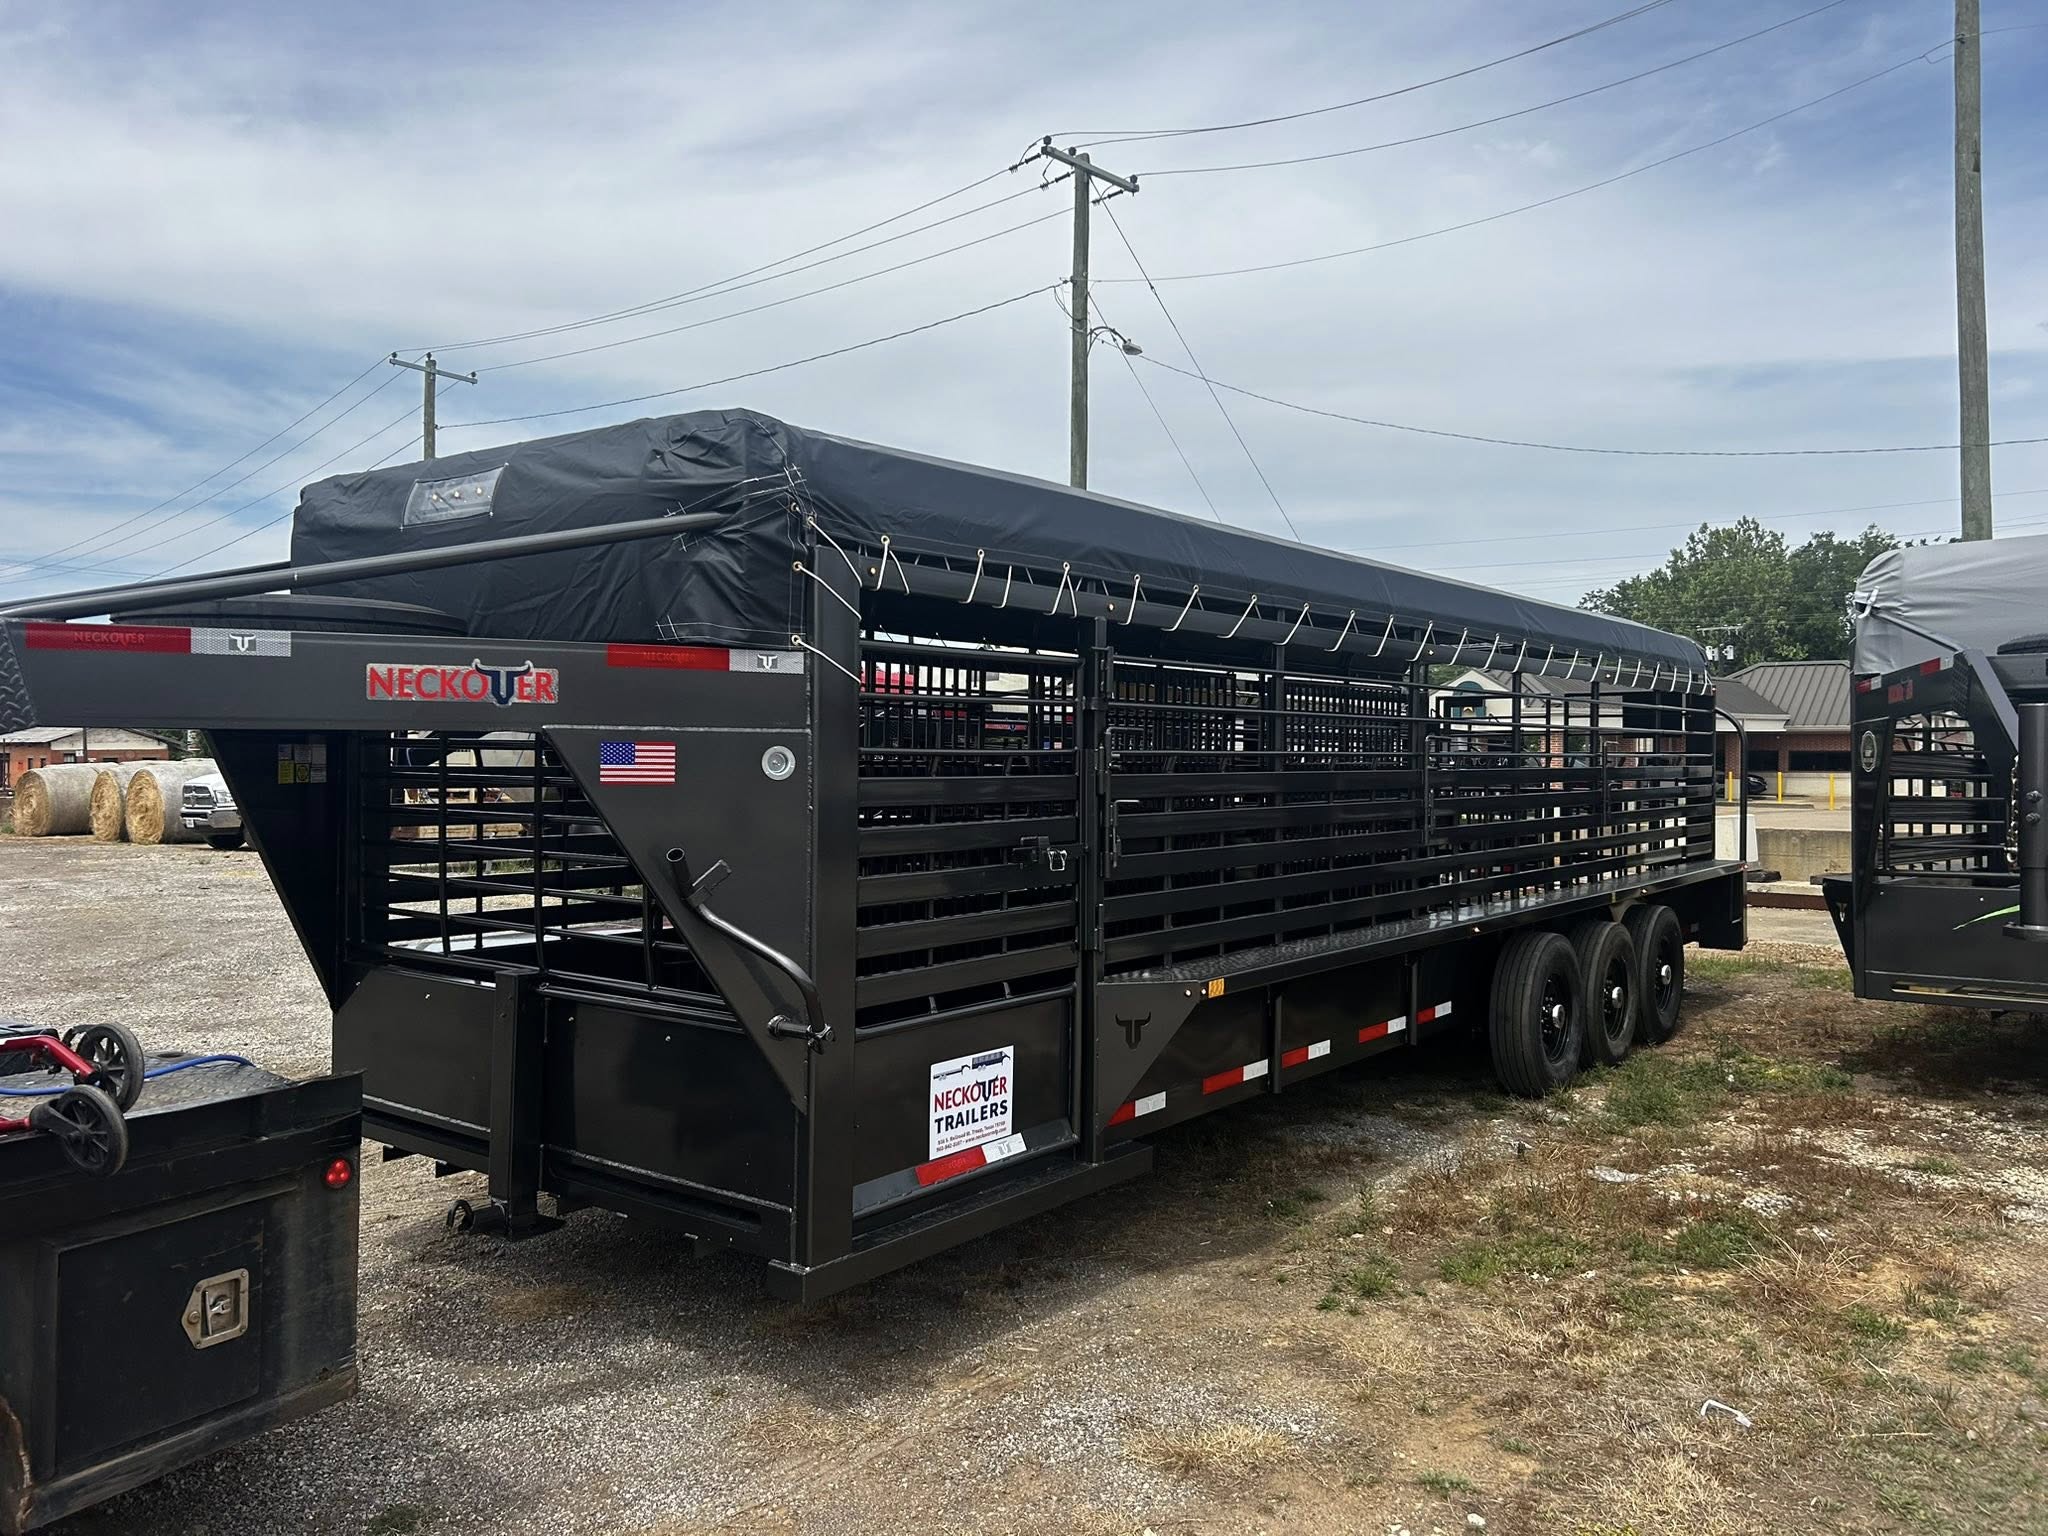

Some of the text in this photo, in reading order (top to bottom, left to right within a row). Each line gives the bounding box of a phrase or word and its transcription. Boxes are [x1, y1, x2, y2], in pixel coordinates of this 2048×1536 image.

[368, 658, 556, 706] NECKOVER
[934, 1074, 1008, 1113] NECKOVER
[935, 1100, 1008, 1134] TRAILERS
